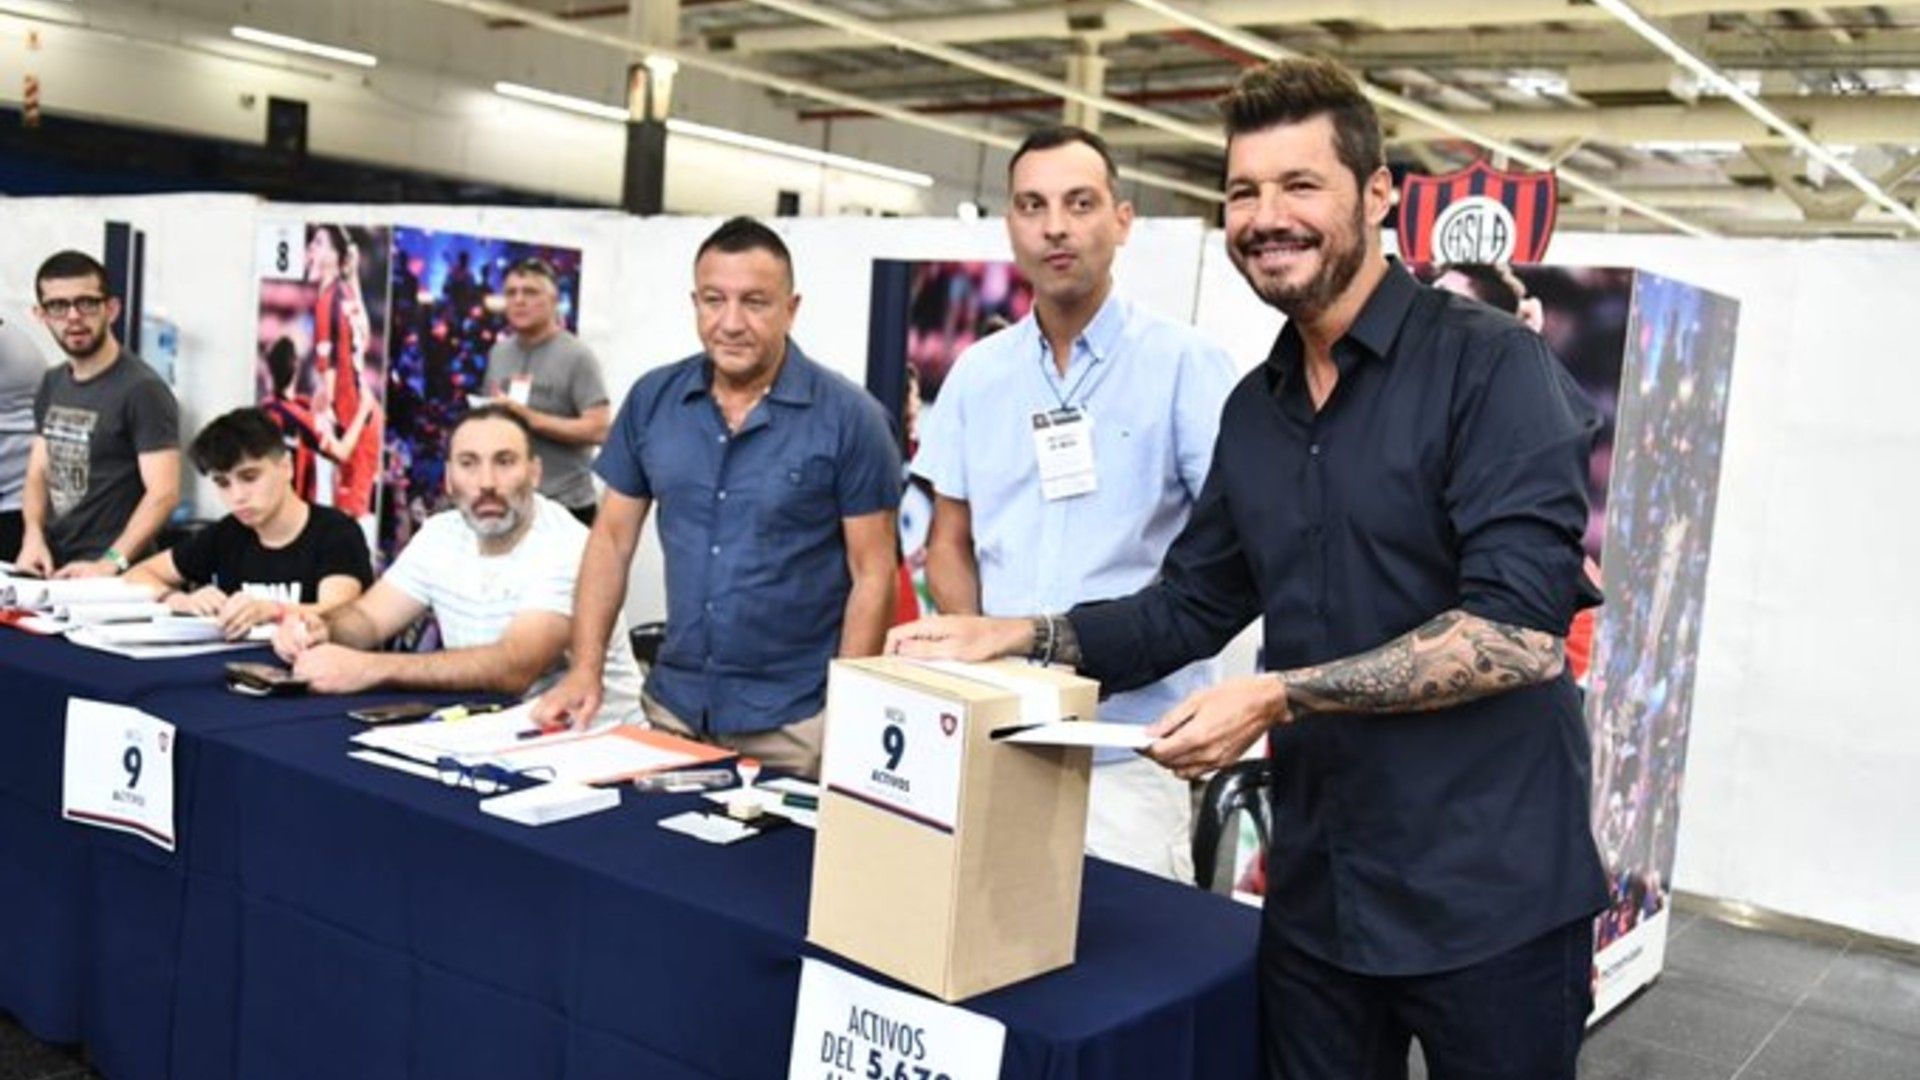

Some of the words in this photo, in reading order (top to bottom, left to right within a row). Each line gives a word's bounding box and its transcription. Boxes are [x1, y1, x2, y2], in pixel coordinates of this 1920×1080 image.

[276, 240, 289, 273] 8
[123, 746, 142, 789] 9
[882, 723, 905, 771] 9
[821, 1031, 856, 1073] DEL
[847, 1005, 926, 1061] ACTIVOS
